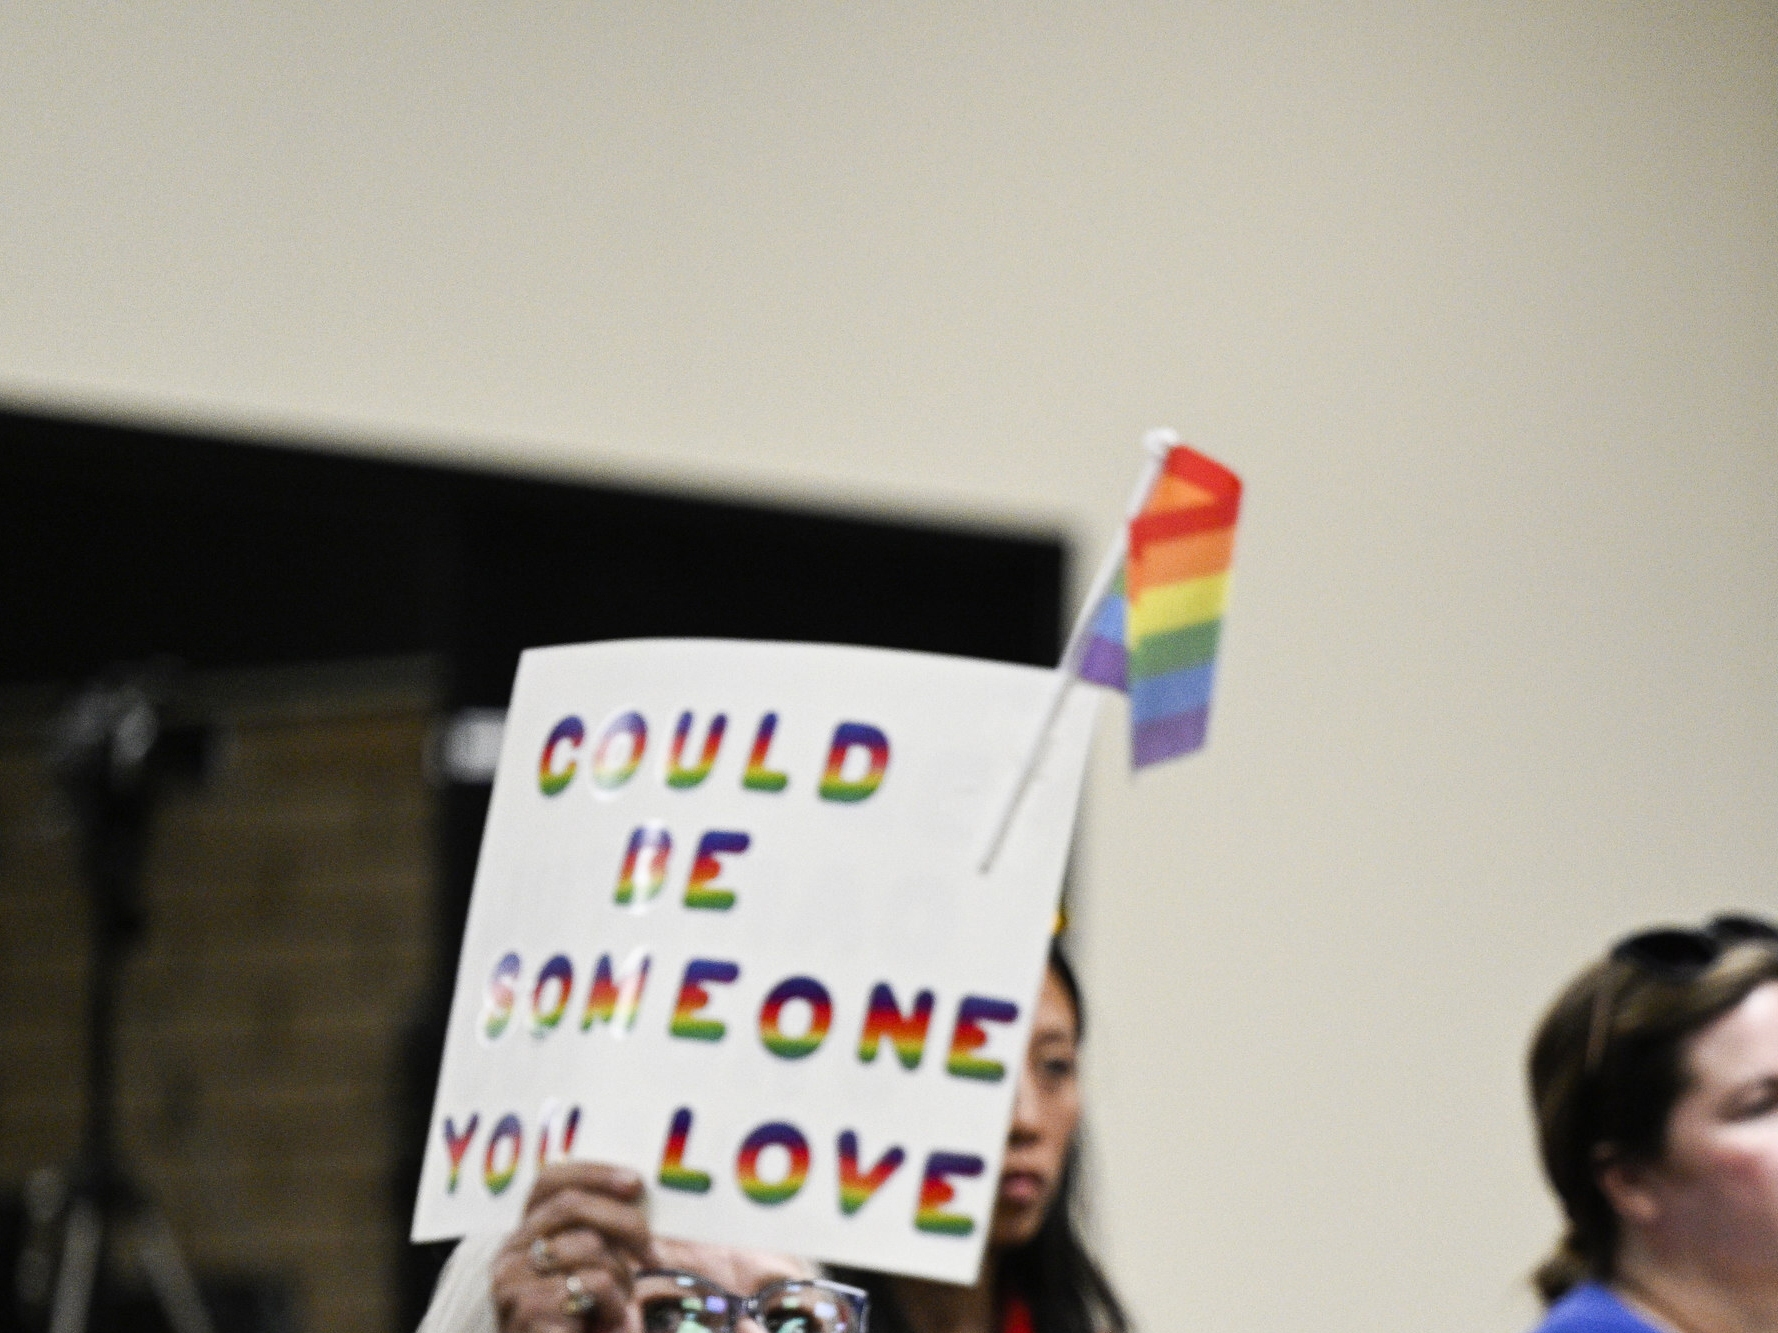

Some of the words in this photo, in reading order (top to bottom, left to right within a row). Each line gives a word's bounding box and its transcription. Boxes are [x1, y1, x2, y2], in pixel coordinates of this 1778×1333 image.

[538, 710, 891, 803] COULD
[614, 824, 751, 911] BE
[483, 951, 1020, 1083] SOMEONE
[656, 1106, 987, 1237] LOVE
